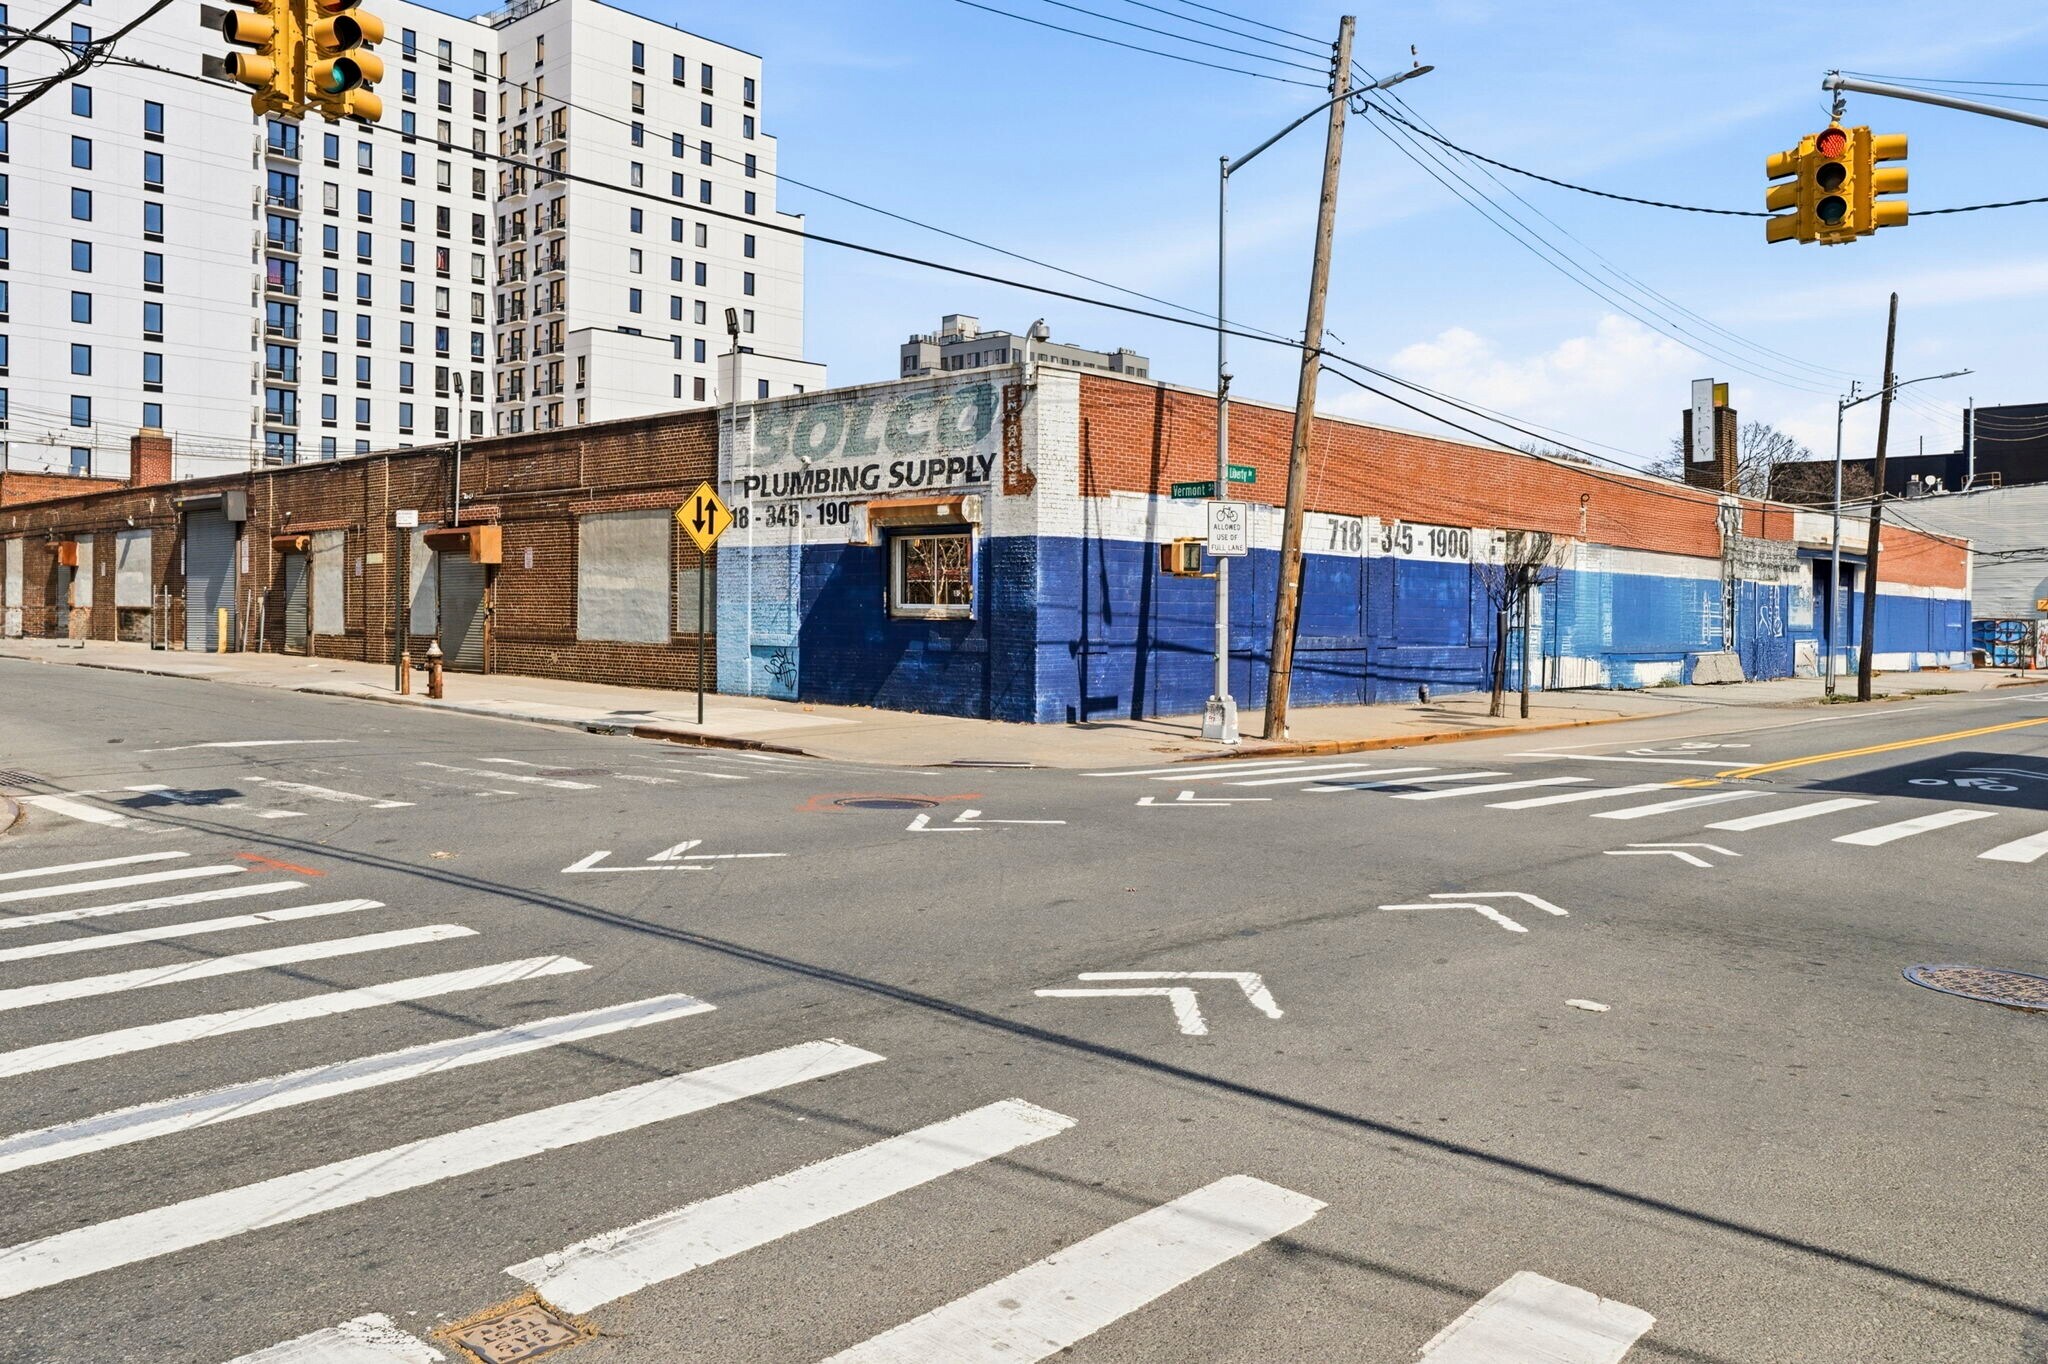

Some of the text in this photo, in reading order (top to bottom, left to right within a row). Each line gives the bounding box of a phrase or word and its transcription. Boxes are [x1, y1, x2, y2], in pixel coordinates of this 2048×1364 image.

[744, 452, 997, 498] PLUMBING SUPPLY
[1230, 467, 1247, 482] Liberty
[1173, 484, 1206, 497] Vermont
[731, 506, 749, 528] 18
[1213, 523, 1240, 531] ALLOWED
[1328, 518, 1361, 552] 718
[1428, 528, 1469, 559] 1900
